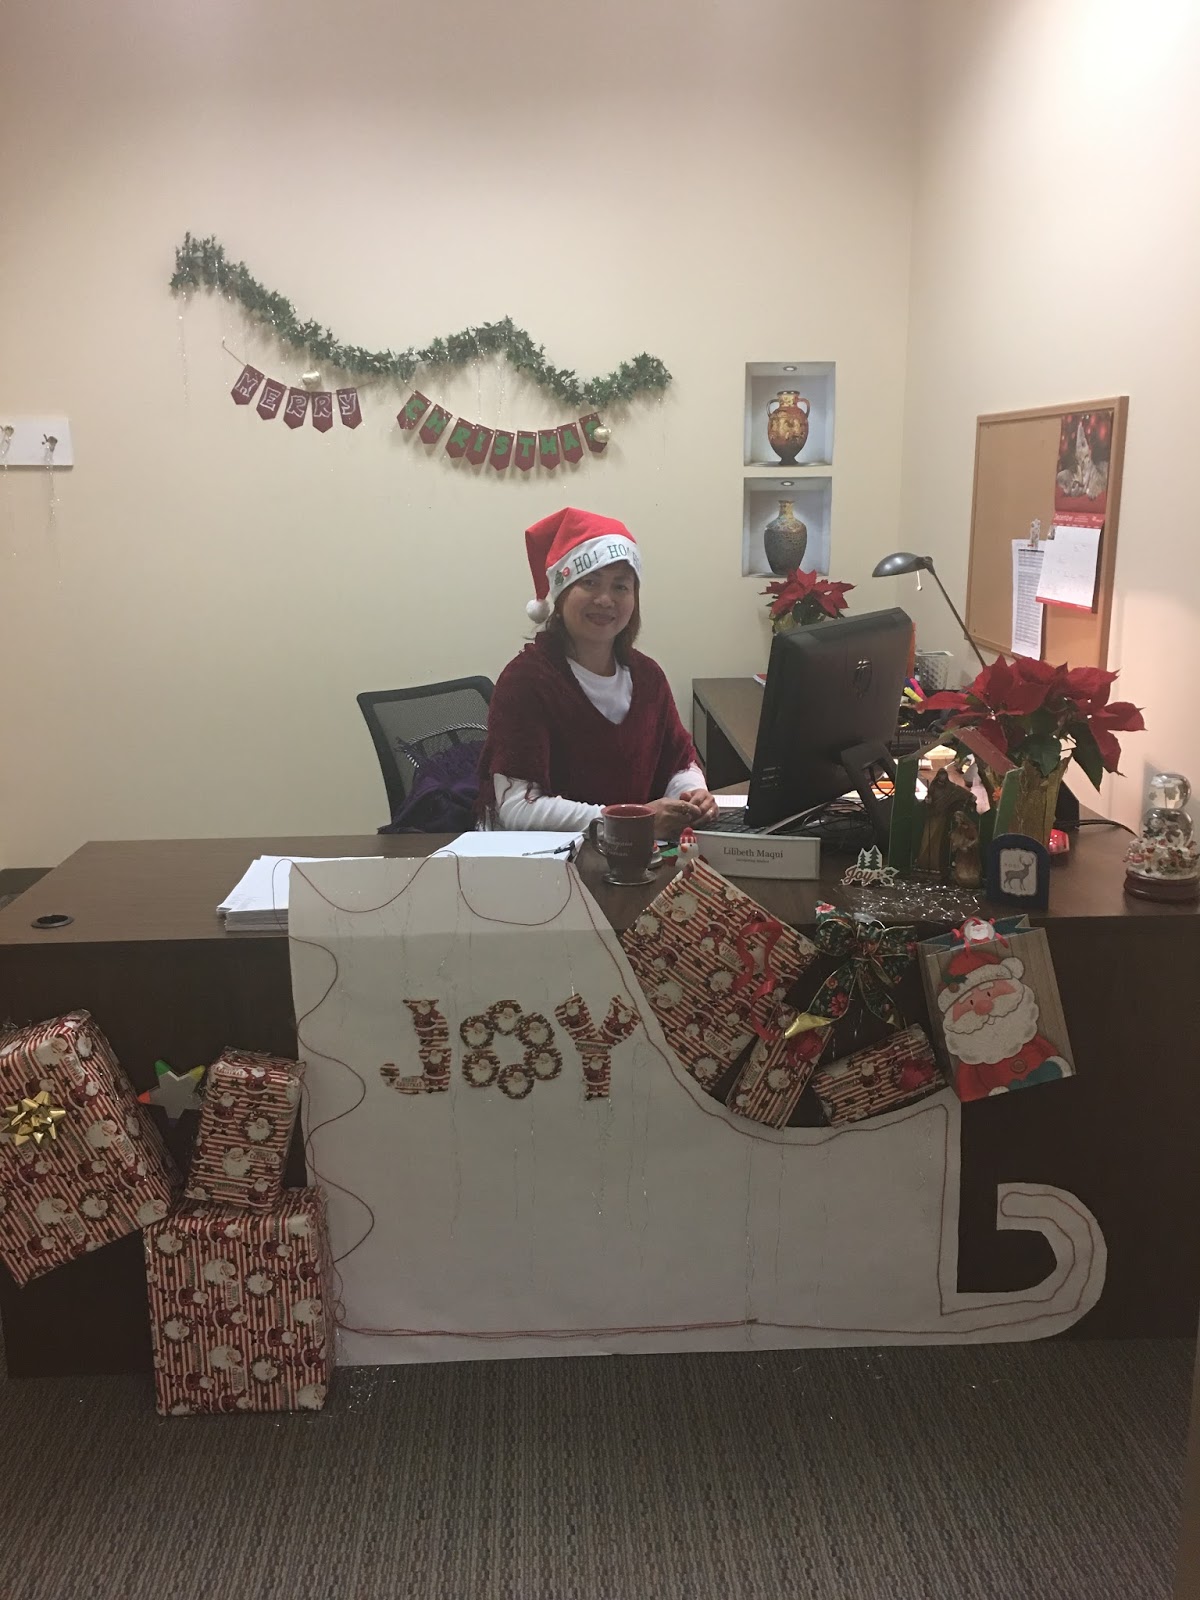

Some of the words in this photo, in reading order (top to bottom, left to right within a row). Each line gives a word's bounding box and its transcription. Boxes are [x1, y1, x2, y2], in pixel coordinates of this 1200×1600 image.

[234, 372, 357, 418] MERRY
[723, 846, 754, 857] Lilibeth
[757, 849, 784, 860] Maqui
[844, 866, 874, 884] Joy
[379, 993, 642, 1101] JOY
